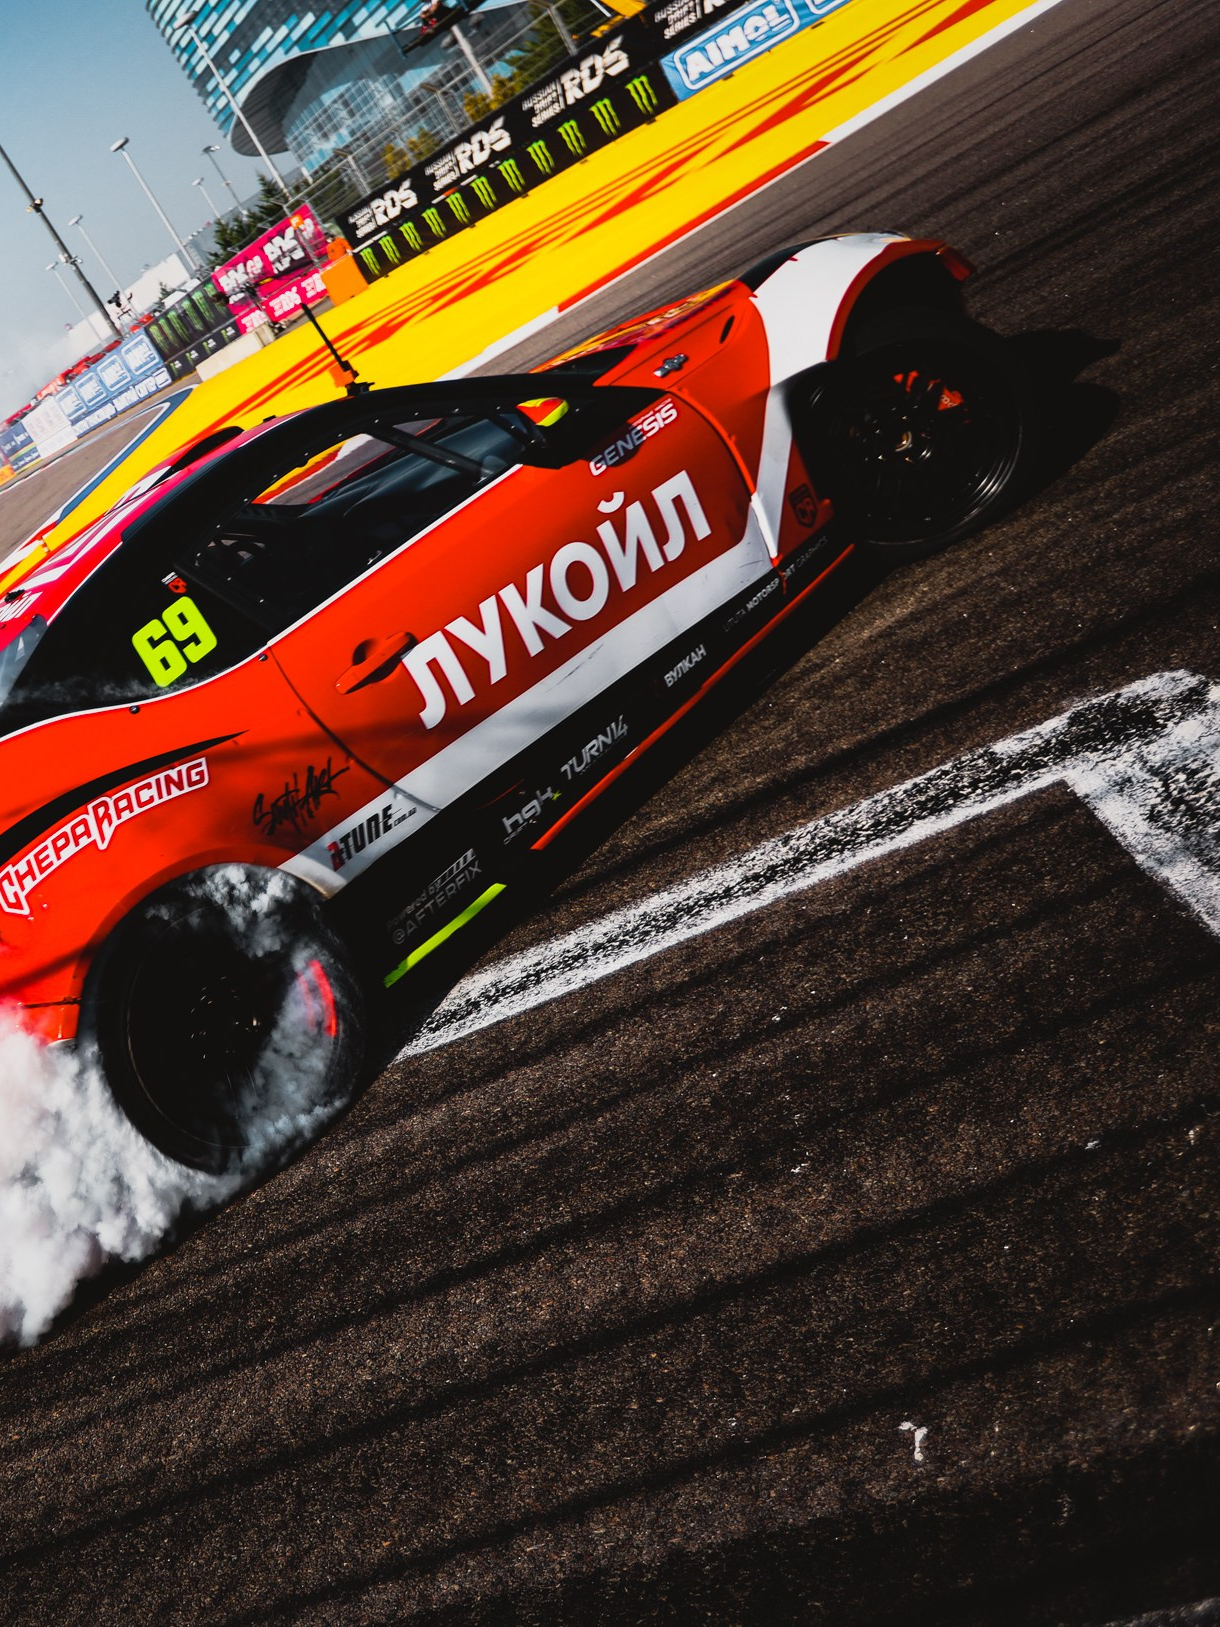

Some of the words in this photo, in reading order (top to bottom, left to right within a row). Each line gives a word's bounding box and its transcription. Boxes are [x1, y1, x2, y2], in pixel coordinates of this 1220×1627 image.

[663, 12, 697, 39] SERIES
[685, 4, 793, 82] AIMOL
[522, 81, 557, 111] RUSSIAN
[560, 35, 630, 105] RDS
[454, 115, 512, 174] RDS
[370, 178, 418, 226] RDS
[589, 402, 678, 477] GENESIS
[401, 470, 712, 730] ЛУКОЙЛ
[131, 596, 218, 688] 69
[663, 644, 707, 688] ВУЛКАН
